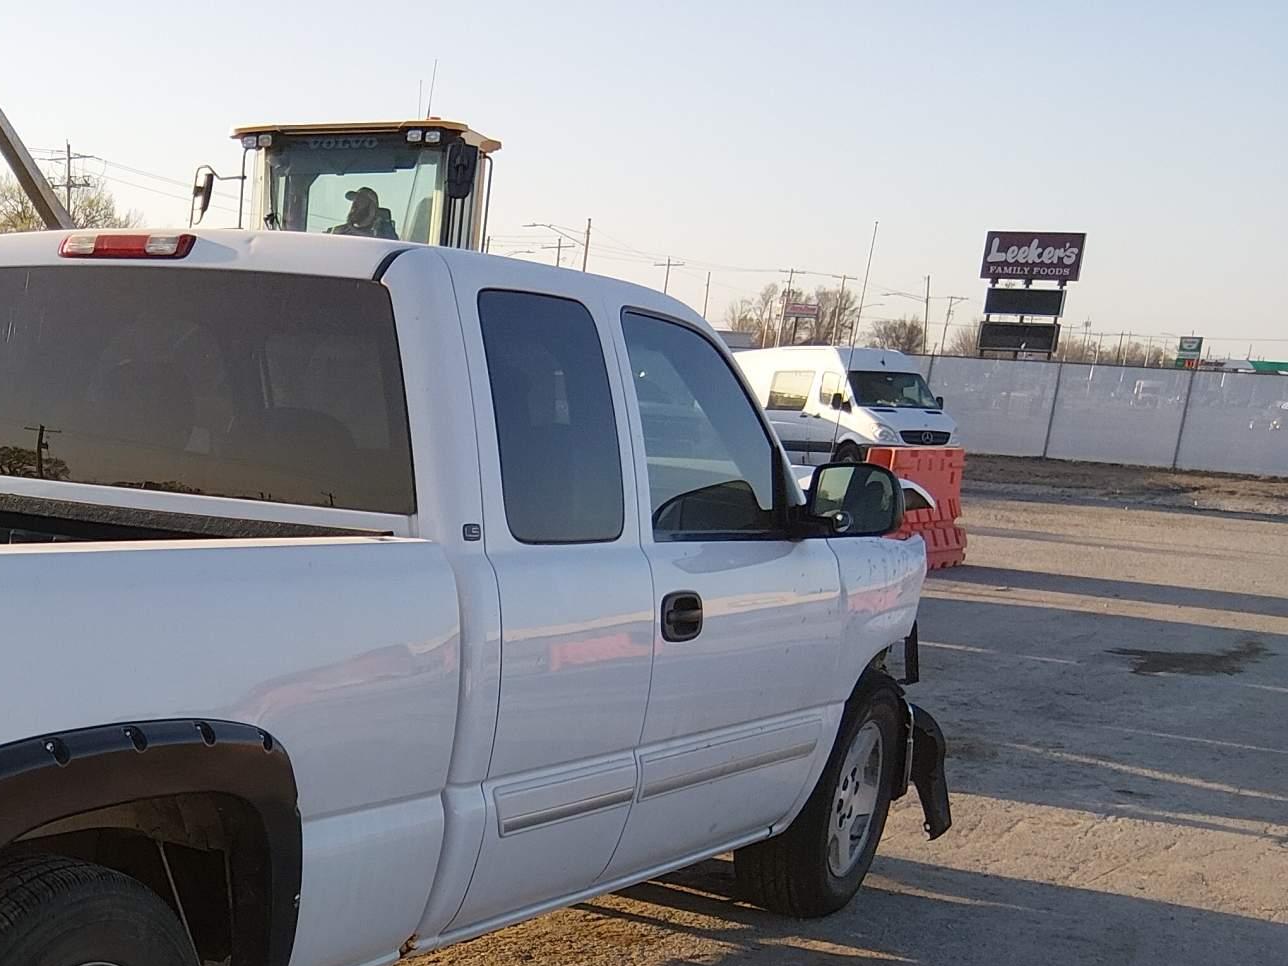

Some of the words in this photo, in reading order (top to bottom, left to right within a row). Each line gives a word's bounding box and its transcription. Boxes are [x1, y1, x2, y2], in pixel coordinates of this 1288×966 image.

[311, 138, 378, 149] VOLVO
[987, 237, 1079, 264] Leeker's
[989, 266, 1030, 275] FAMILY
[1032, 267, 1070, 276] FOODS
